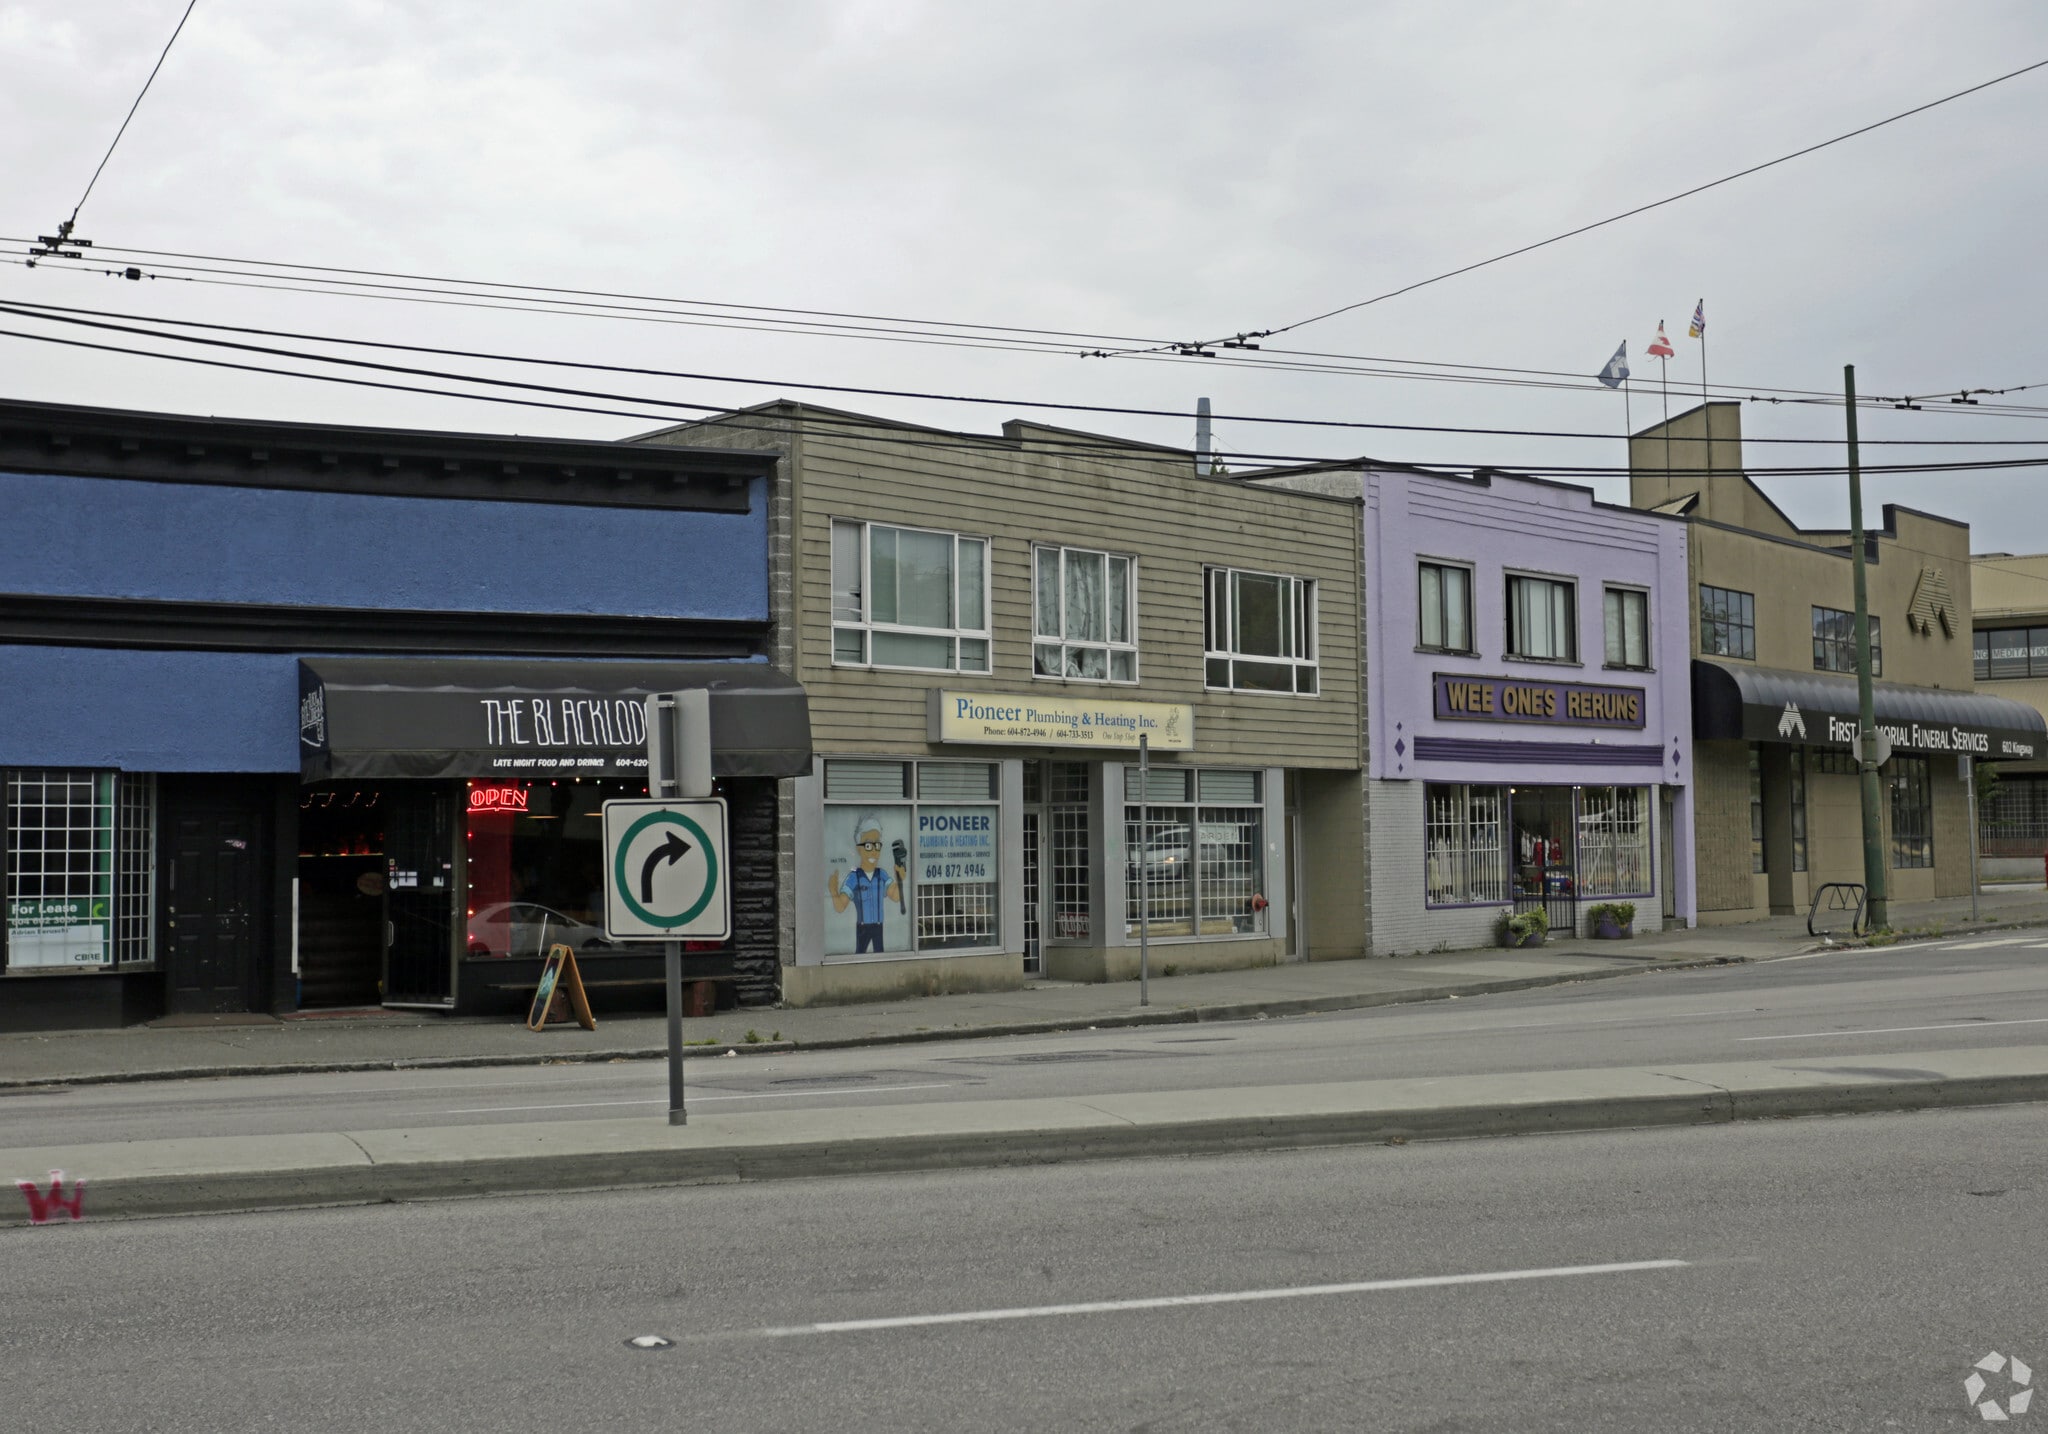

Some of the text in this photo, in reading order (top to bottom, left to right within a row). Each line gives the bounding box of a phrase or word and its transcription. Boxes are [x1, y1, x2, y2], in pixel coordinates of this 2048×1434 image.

[1446, 682, 1639, 722] WEE ONES RERUNS
[480, 699, 648, 746] THE BLACKLOD
[956, 698, 1158, 731] Pioneer Plumbing & Heating Inc.
[984, 726, 1006, 736] Phone:
[1007, 727, 1046, 738] 604-872-4946
[1829, 716, 1989, 752] FIRST ORIAL FUNERAL SERVICES
[2002, 741, 2034, 757] 602 Kingsway
[493, 759, 512, 767] LATE
[513, 759, 537, 767] NIGHT
[538, 759, 557, 767] FOOD
[559, 759, 575, 767] AND
[577, 758, 604, 767] DRINKS
[470, 788, 528, 807] OPEN
[919, 816, 990, 831] PIONEER
[926, 863, 985, 878] 604 872 4946
[11, 903, 78, 915] For Lease
